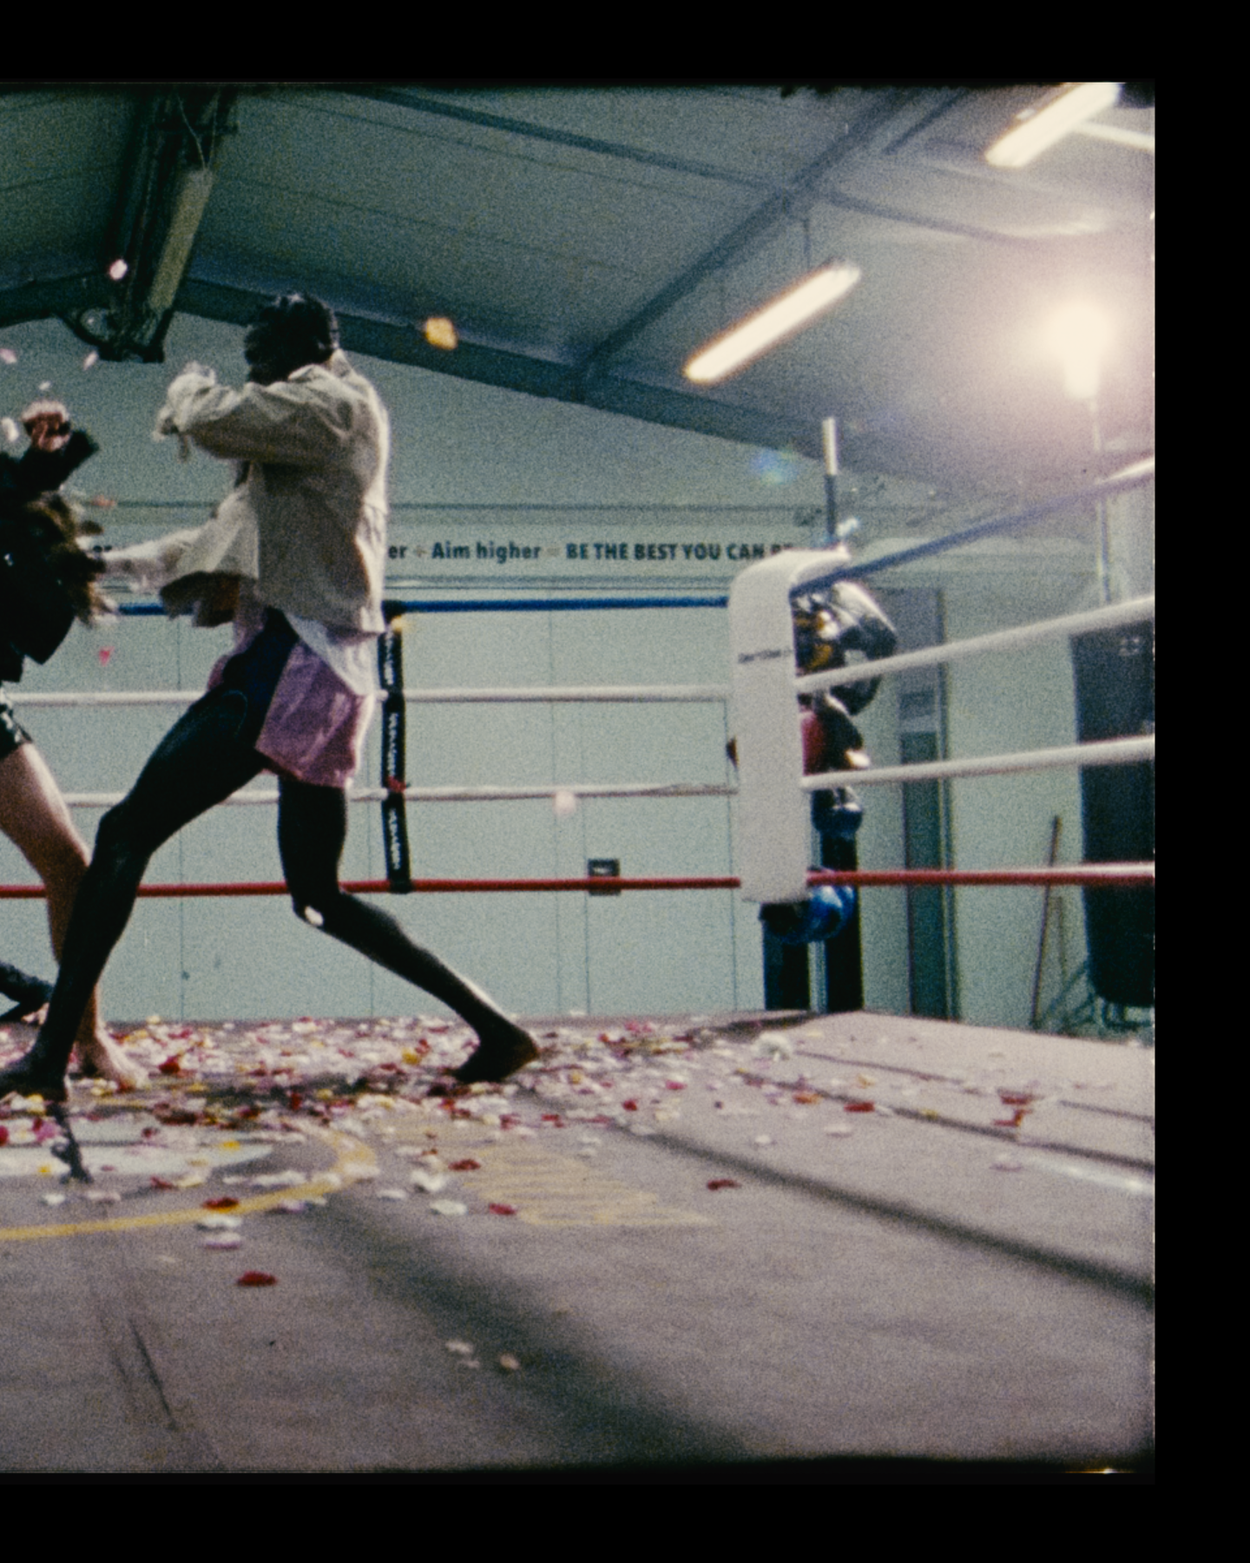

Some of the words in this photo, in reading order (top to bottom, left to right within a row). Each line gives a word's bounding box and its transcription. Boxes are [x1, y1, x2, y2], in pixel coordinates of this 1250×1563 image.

[388, 545, 408, 560] er
[432, 541, 470, 560] Aim
[476, 541, 541, 564] higher
[566, 543, 588, 560] BE
[594, 543, 628, 560] THE
[634, 543, 678, 560] BEST
[682, 543, 721, 560] YOU
[726, 543, 765, 560] CAN
